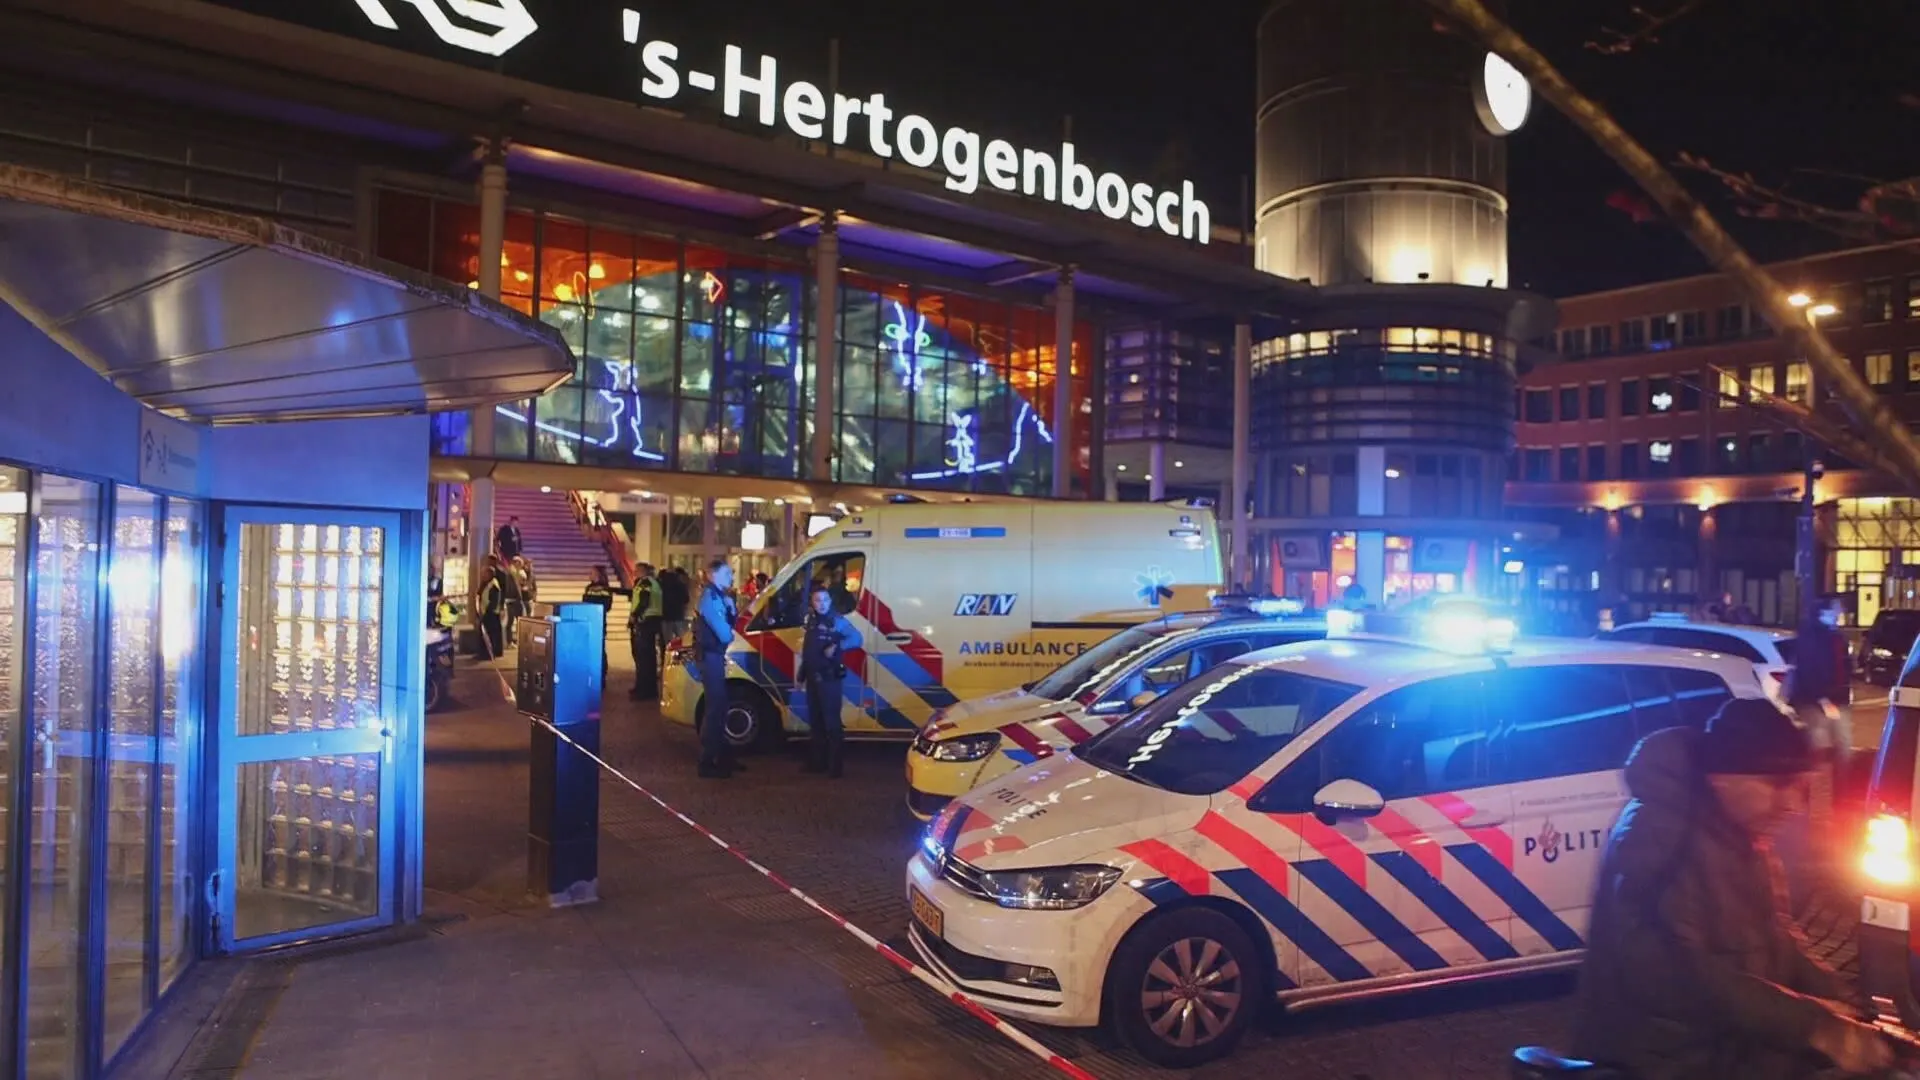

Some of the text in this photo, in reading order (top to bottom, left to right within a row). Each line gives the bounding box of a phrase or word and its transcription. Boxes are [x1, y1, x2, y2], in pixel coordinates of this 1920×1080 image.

[622, 9, 1210, 244] 's-Hertogenbosch
[955, 594, 1017, 616] RAV
[959, 641, 1088, 656] AMBULANCE
[1524, 830, 1602, 863] POLIT
